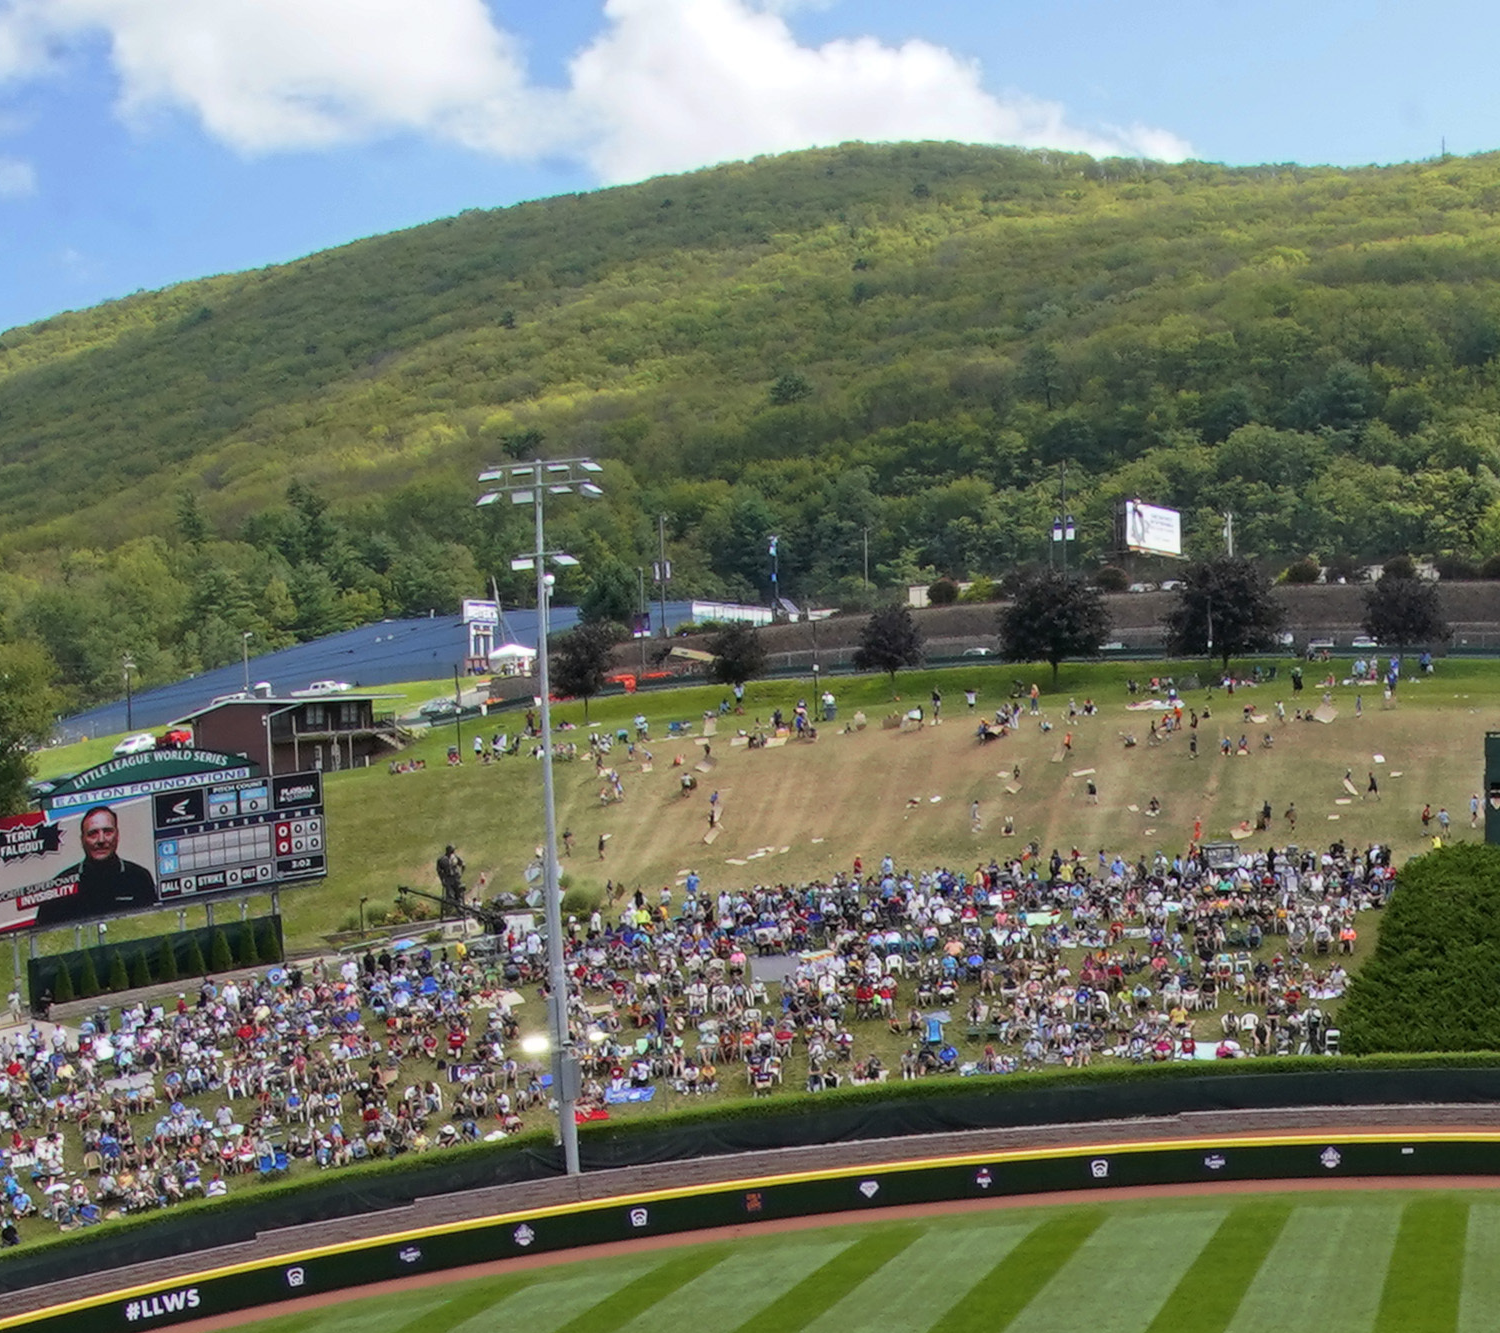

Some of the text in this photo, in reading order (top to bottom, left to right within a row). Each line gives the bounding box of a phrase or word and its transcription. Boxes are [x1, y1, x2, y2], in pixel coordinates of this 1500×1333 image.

[72, 751, 228, 789] LITTLE LEAGUE WORLD SERIES
[55, 769, 247, 806] EASTON FOUNDATIONS
[0, 840, 45, 857] FALGOUT
[5, 828, 40, 844] TERRY
[126, 1289, 200, 1321] #LLWS
